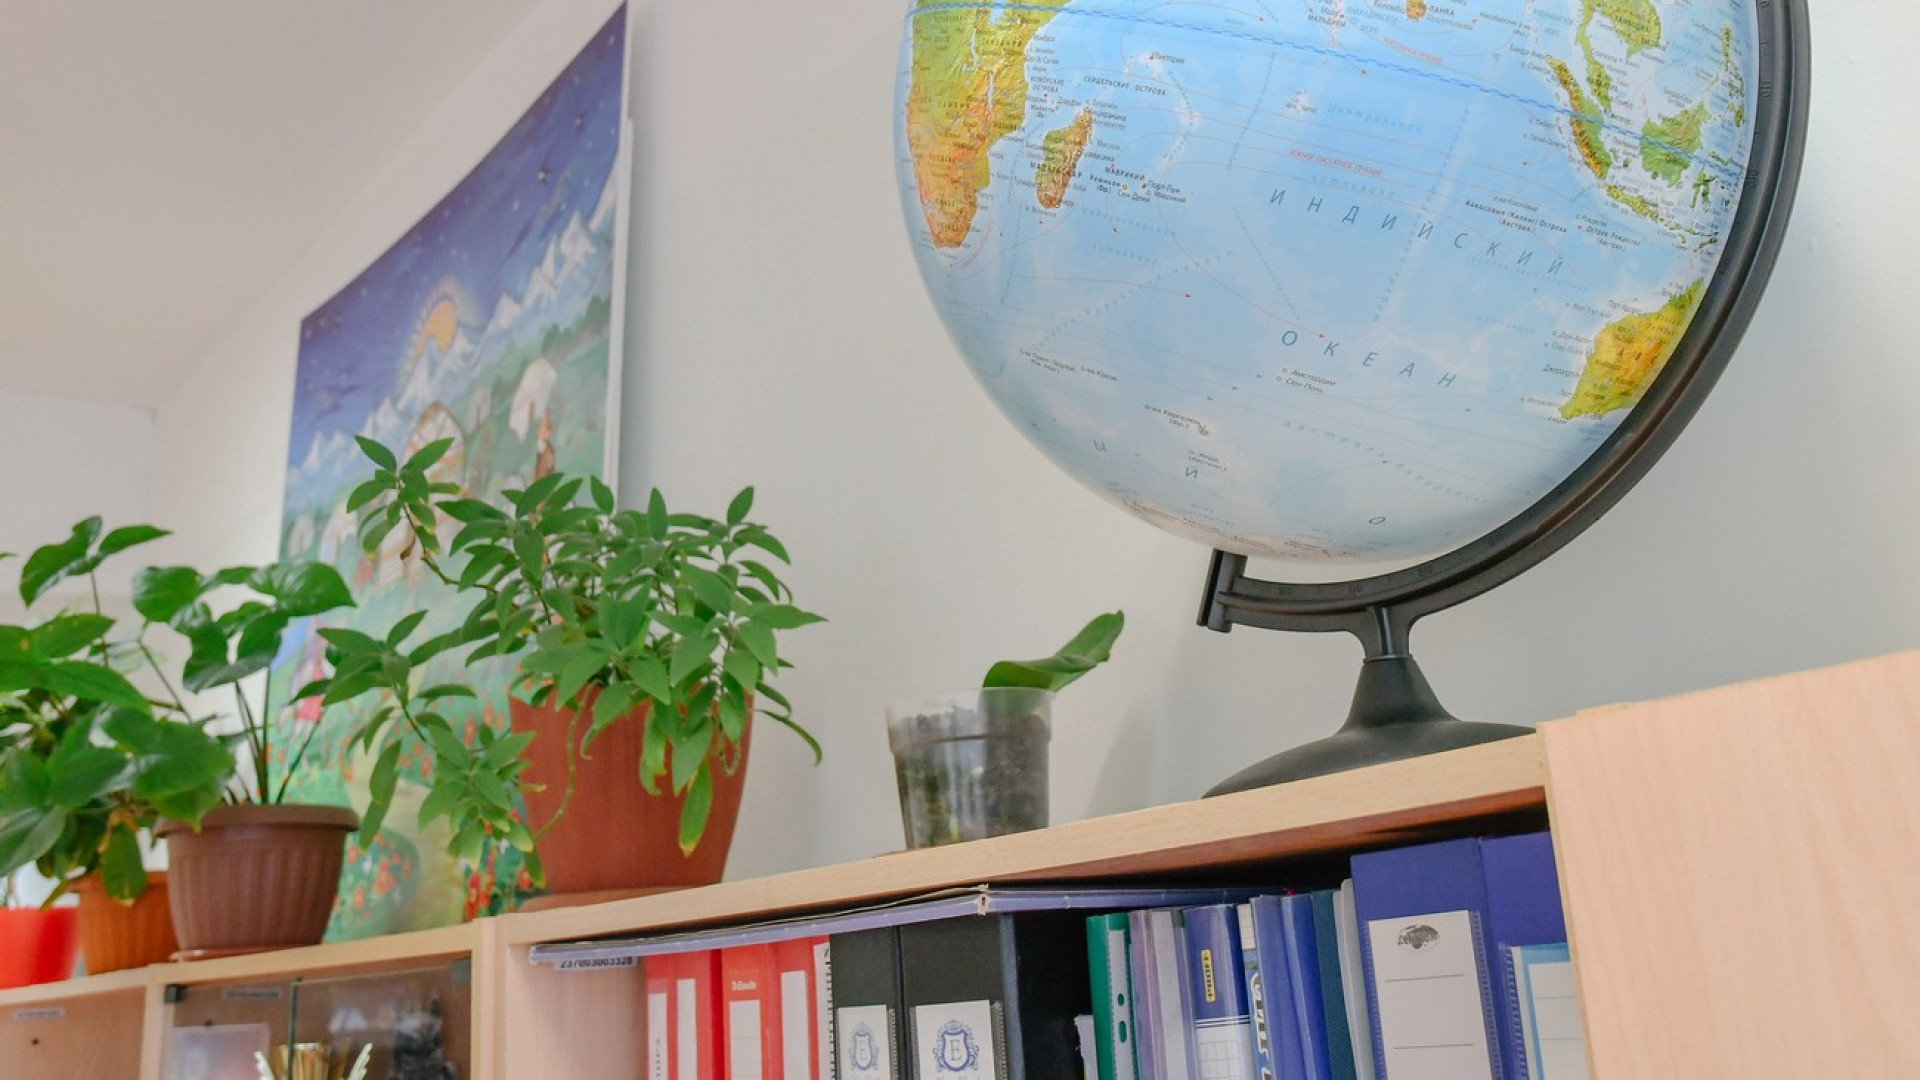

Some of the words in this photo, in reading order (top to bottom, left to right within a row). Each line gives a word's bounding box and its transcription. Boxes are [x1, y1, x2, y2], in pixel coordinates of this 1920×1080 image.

[1135, 84, 1166, 97] ОСТРОВА
[1105, 166, 1145, 181] МАВРИКИЙ
[1269, 187, 1564, 276] ИНДИЙСКИЙ
[1280, 329, 1457, 388] ОКЕАН
[949, 1039, 963, 1062] E
